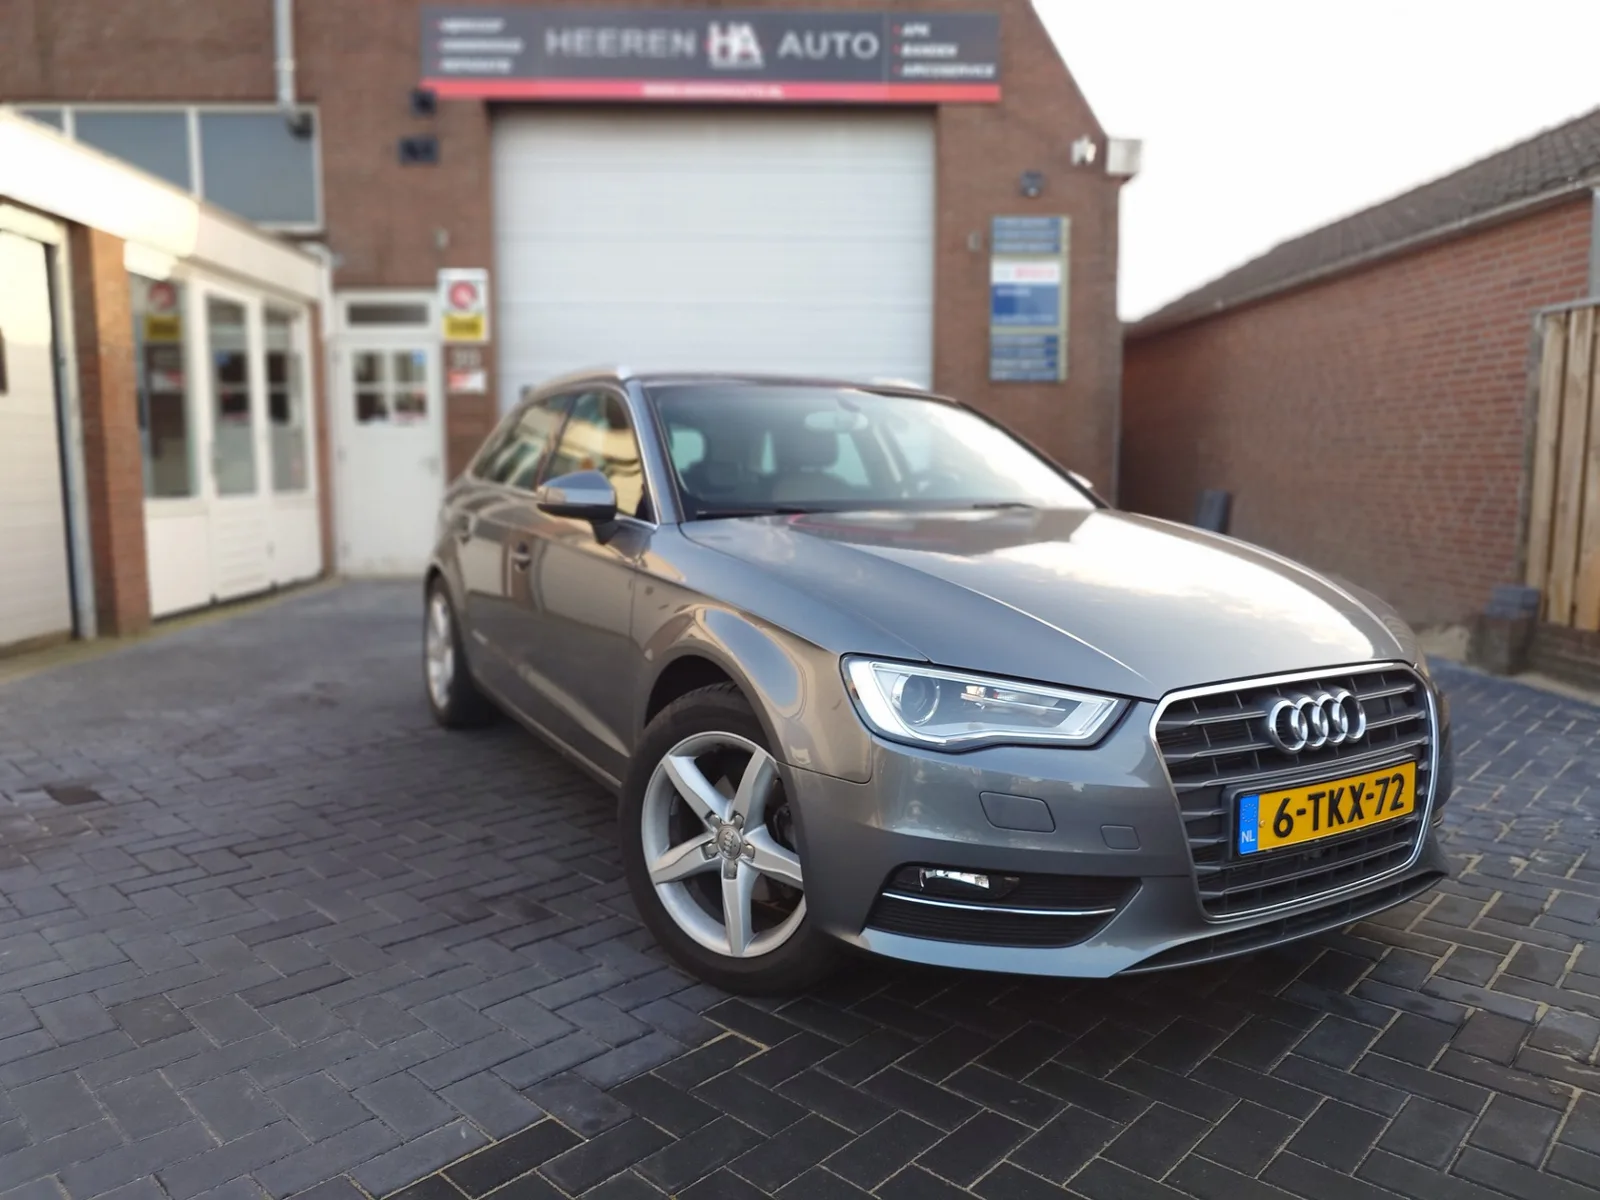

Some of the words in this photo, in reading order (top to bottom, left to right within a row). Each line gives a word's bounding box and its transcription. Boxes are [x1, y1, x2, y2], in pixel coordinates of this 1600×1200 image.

[545, 28, 697, 58] HEEREN
[777, 31, 880, 60] AUTO
[1273, 773, 1405, 838] 6-TKX-72
[1241, 830, 1256, 844] NL
